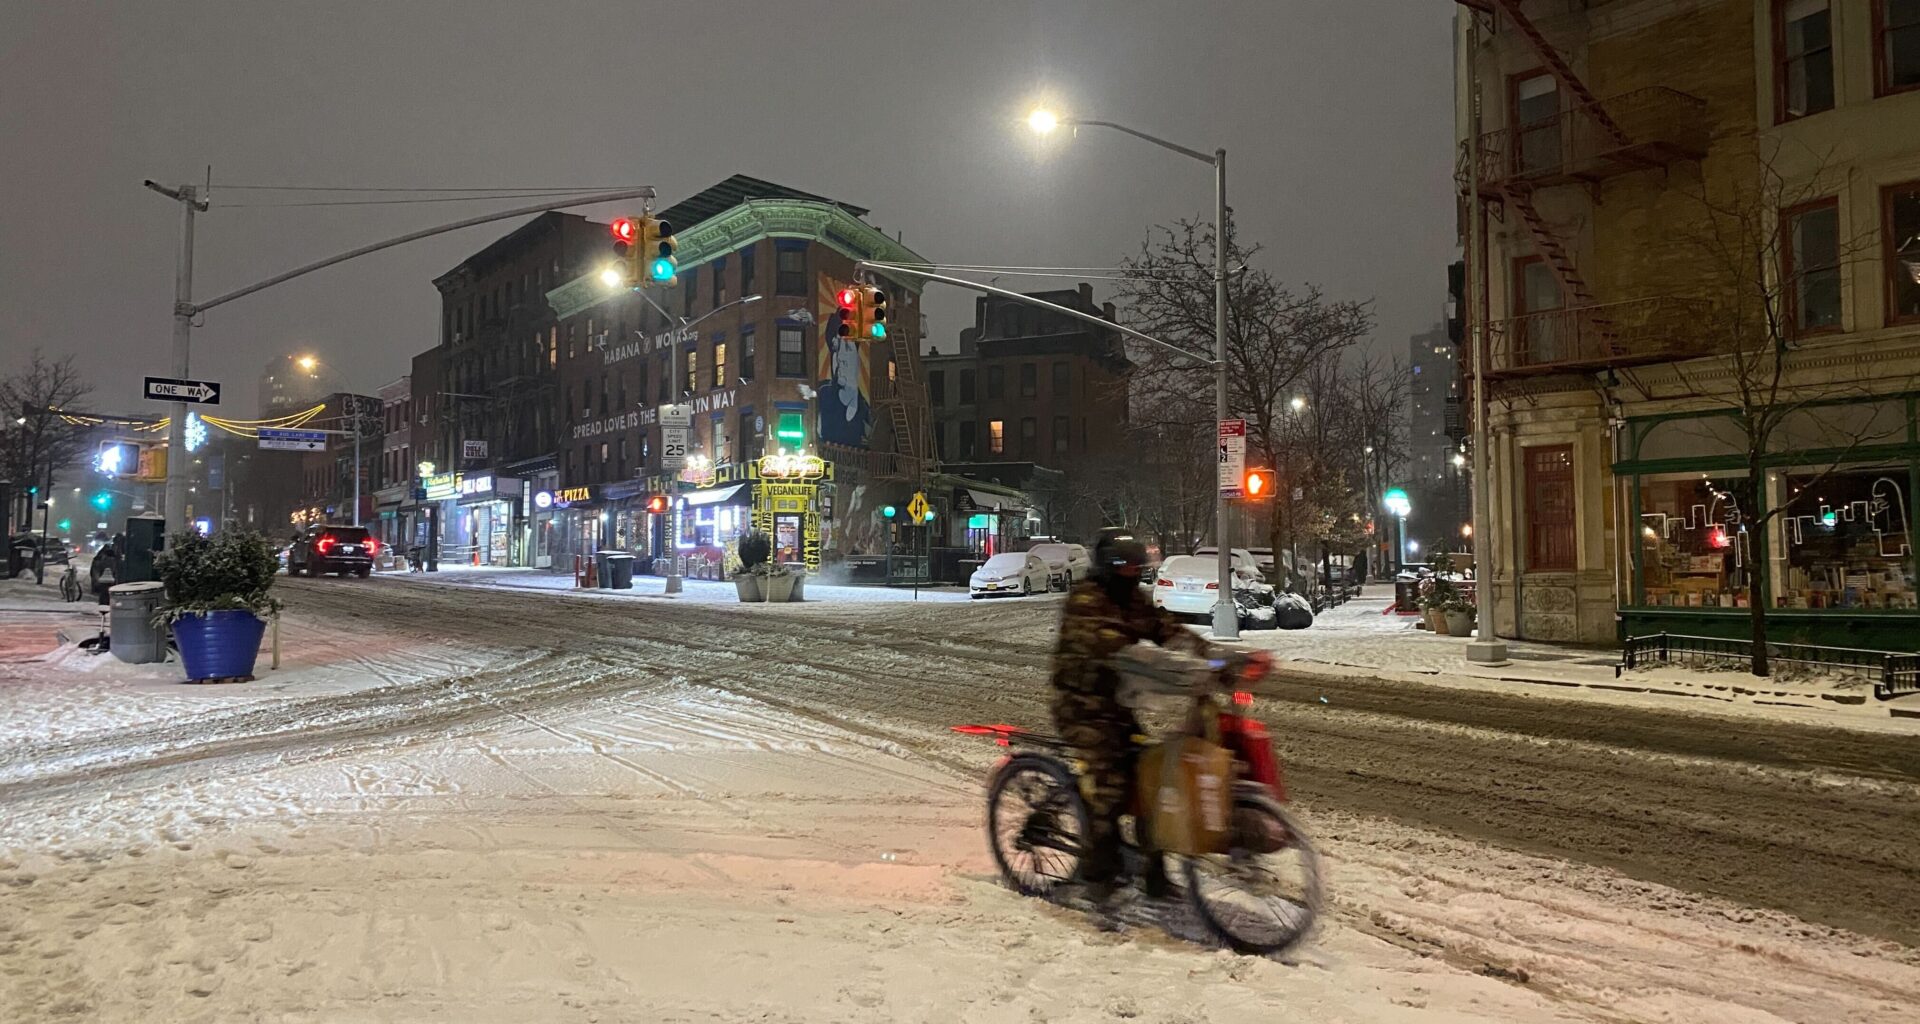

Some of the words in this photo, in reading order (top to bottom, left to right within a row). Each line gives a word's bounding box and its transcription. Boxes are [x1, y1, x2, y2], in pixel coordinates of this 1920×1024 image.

[604, 342, 640, 365] HABANA
[155, 384, 178, 394] ONE
[187, 387, 209, 397] WAY
[573, 420, 601, 439] SPREAD
[640, 408, 656, 425] THE
[712, 390, 736, 409] WAY
[665, 444, 685, 456] 25
[564, 487, 590, 503] PIZZA
[766, 485, 794, 496] VEGAN
[800, 486, 812, 496] LIFE
[761, 512, 772, 533] LANTS
